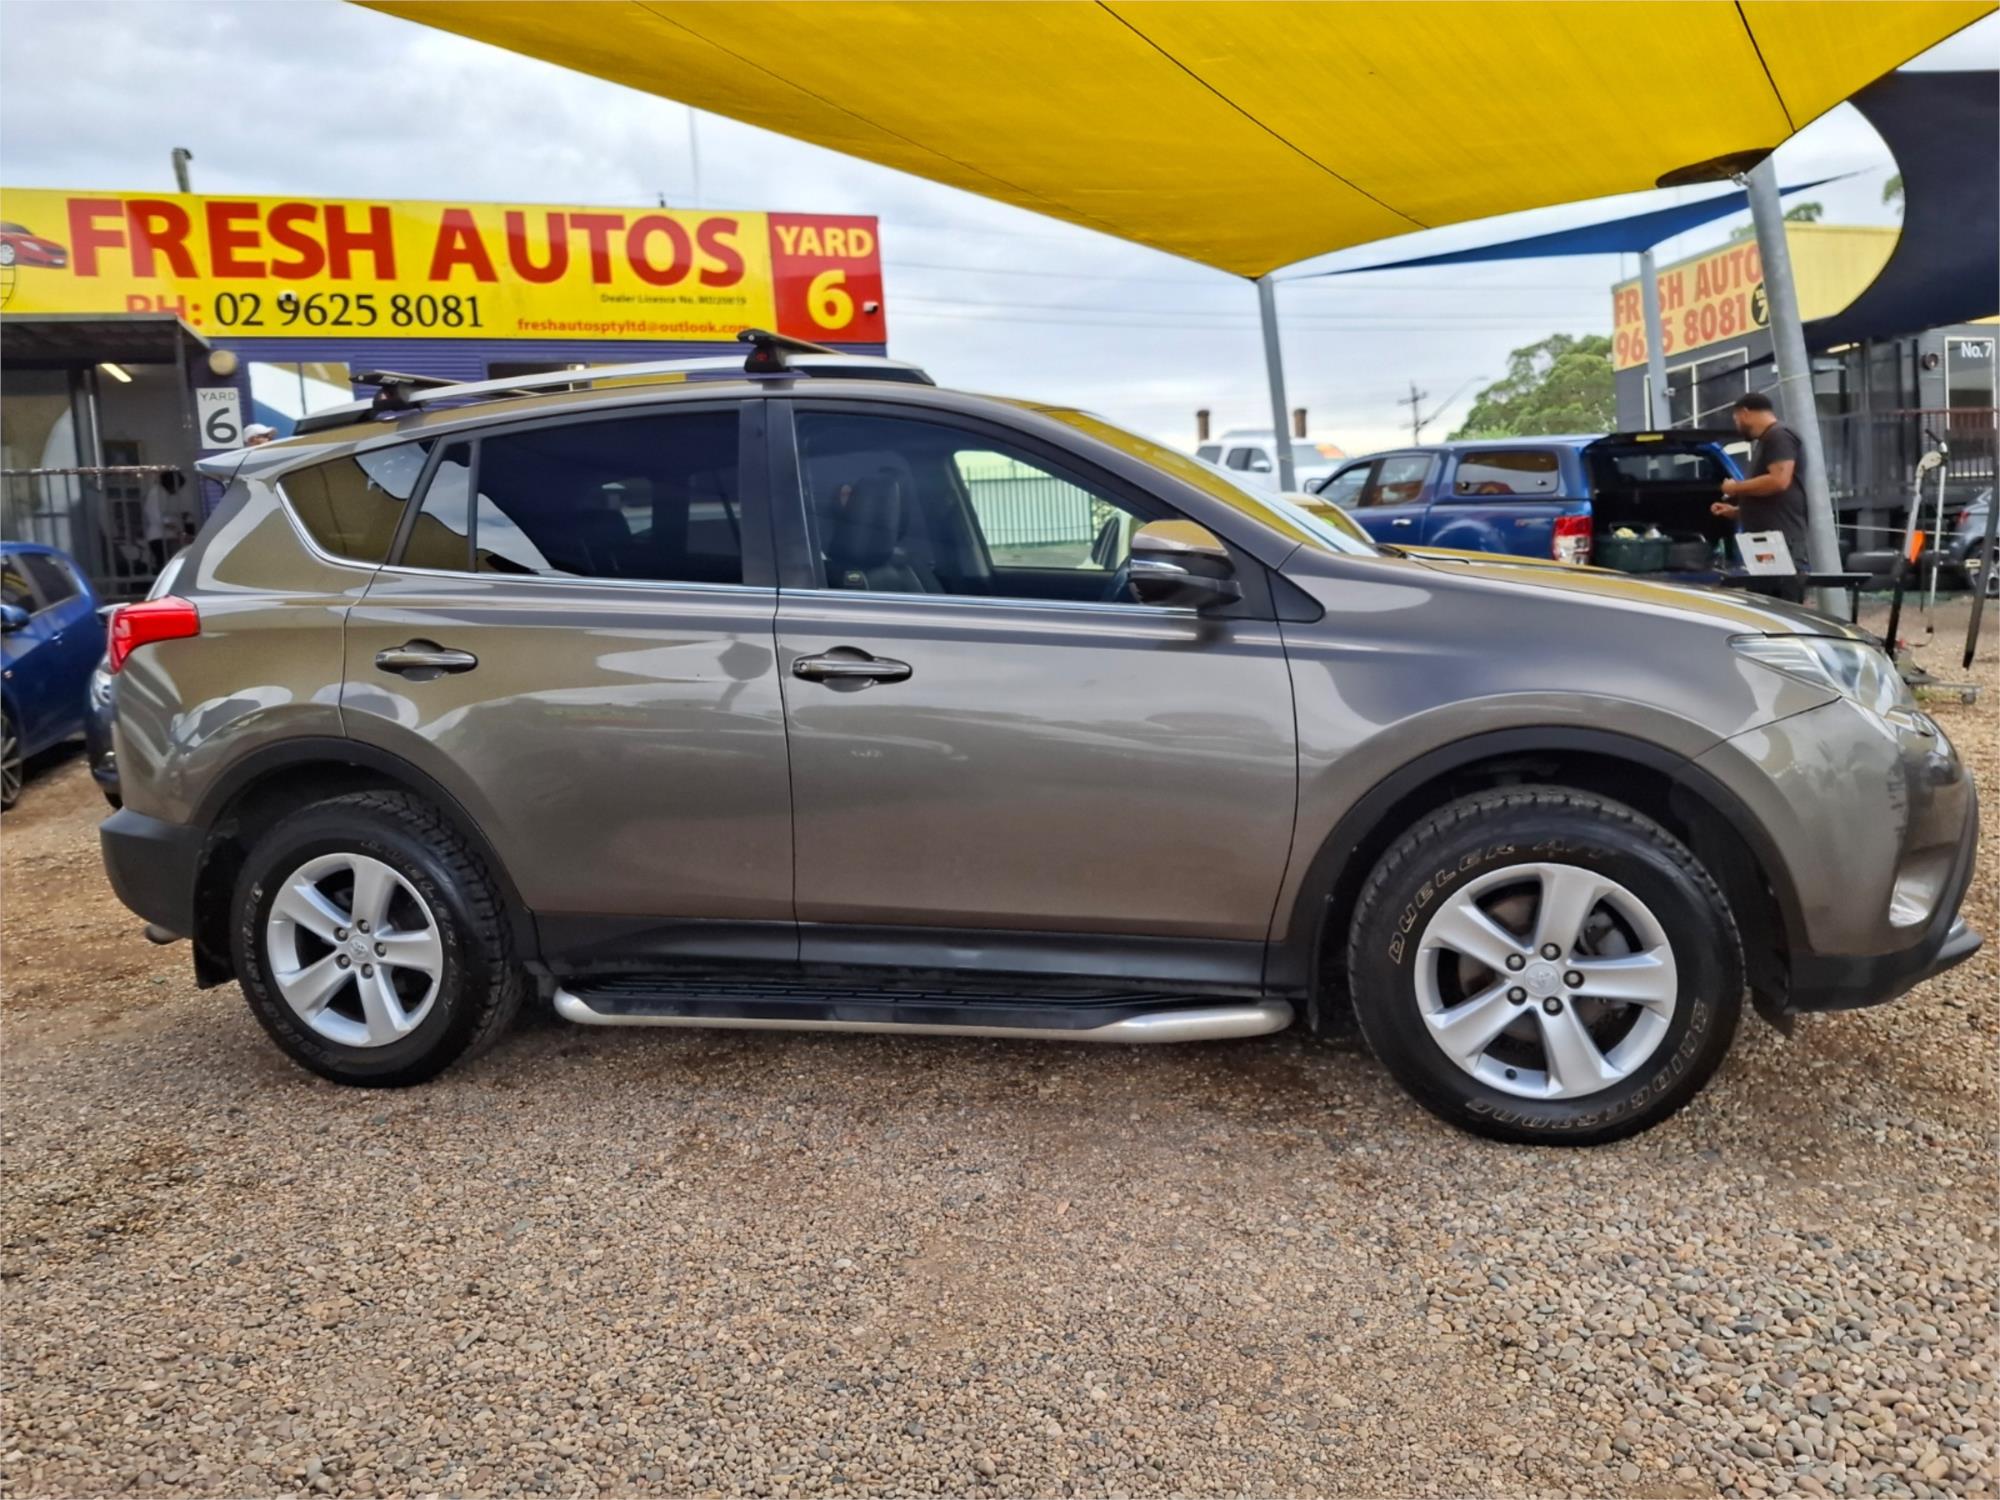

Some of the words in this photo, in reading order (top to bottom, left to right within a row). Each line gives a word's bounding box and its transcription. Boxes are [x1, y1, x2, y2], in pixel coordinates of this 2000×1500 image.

[67, 198, 397, 281] FRESH
[428, 208, 745, 288] AUTOS
[775, 226, 874, 258] YARD
[214, 292, 264, 326] 02
[277, 293, 377, 326] 9625
[390, 294, 484, 328] 8081
[806, 269, 854, 329] 6
[1614, 271, 1684, 326] FRSH
[1616, 318, 1674, 366] 965
[1684, 292, 1748, 346] 8081
[200, 391, 236, 401] YARD
[206, 407, 237, 443] 6
